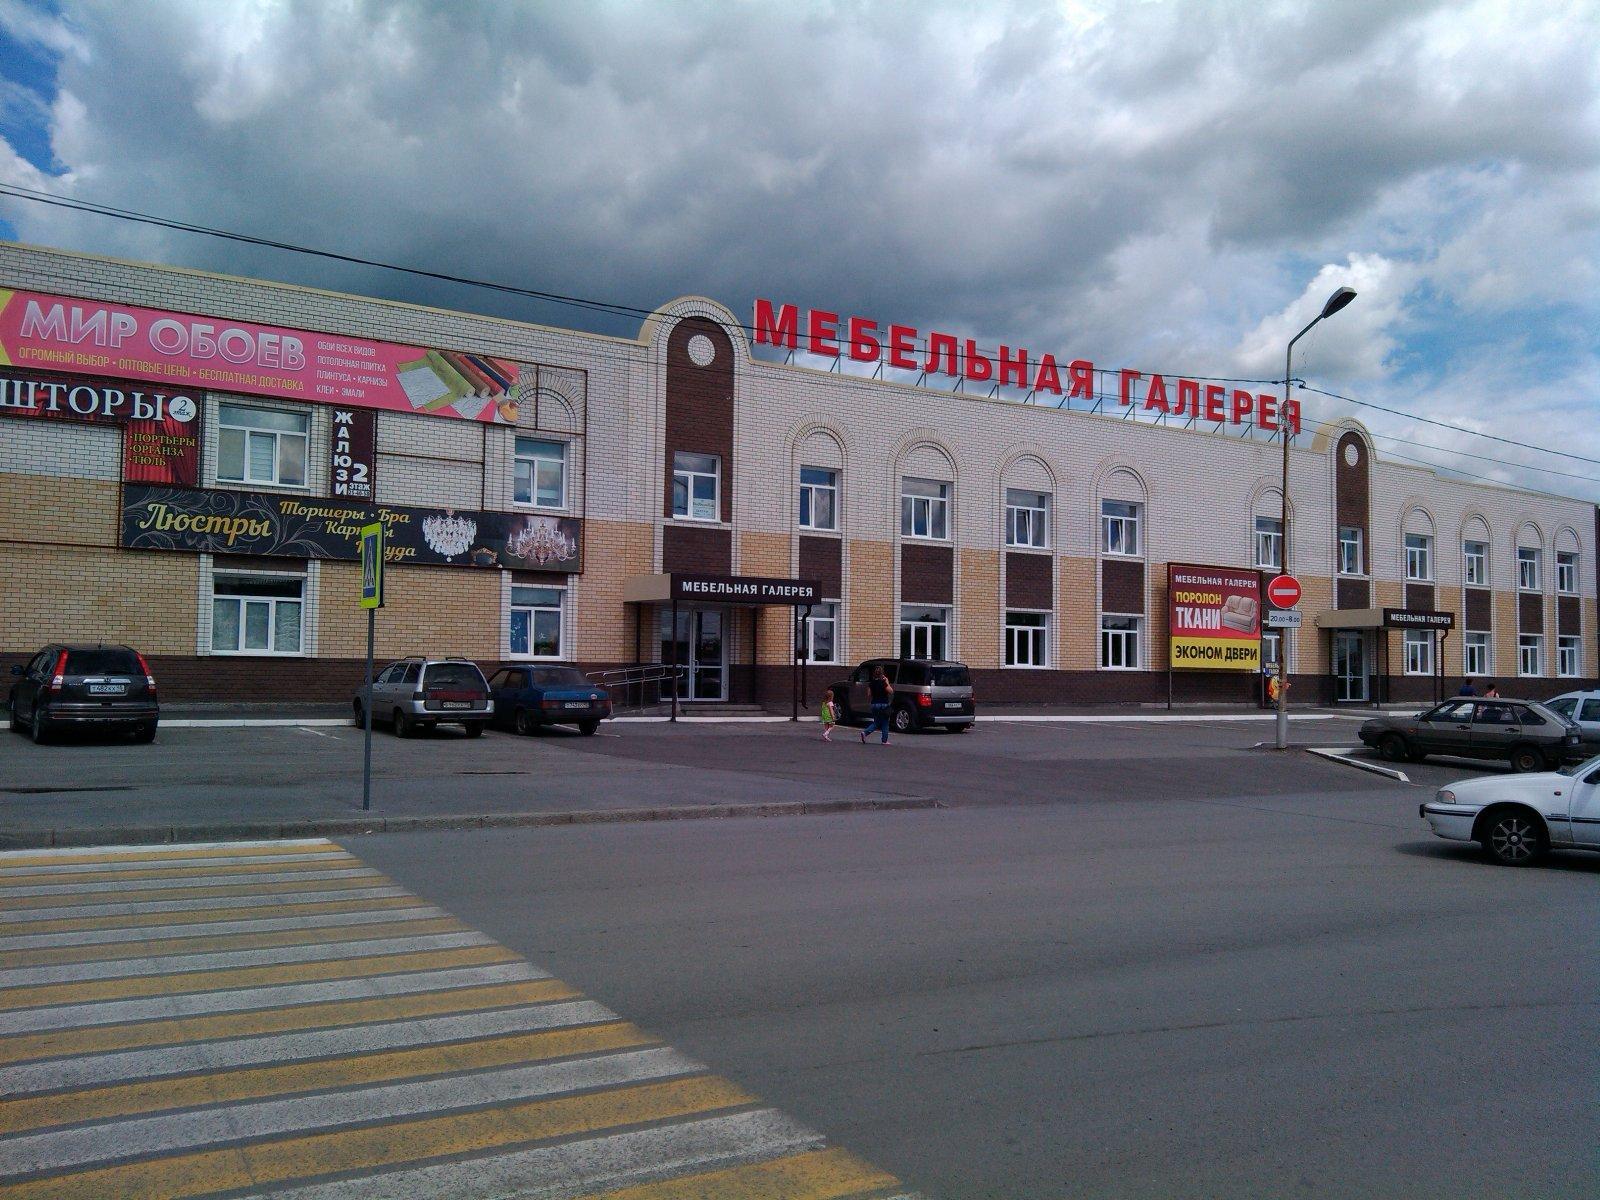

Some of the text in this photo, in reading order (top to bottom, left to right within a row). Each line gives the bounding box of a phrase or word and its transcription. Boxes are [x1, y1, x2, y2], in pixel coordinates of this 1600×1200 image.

[20, 300, 307, 371] МИР ОБОЕВ
[317, 341, 376, 357] ОБОИ ВСЕХ ВИДОВ
[19, 347, 305, 392] ОГРОМНЫЙ ВЫБОР ОПТОВЫЕ ЦЕНЫ БЕСПЛАТНАЯ ДОСТАВКА
[317, 355, 386, 372] ПОТОЛОЧНАЯ ПЛИТКА
[753, 299, 1302, 435] МЕБЕЛЬНАЯ ГАЛЕРЕЯ
[316, 369, 388, 387] ПЛИНТУСА КАРНИЗЫ
[0, 379, 168, 421] ШТОРЫ
[341, 387, 365, 398] ЭМАЛИ
[178, 399, 188, 411] 2
[134, 433, 195, 447] ПОРТЬЕРЫ
[133, 444, 185, 458] ОРГАНЗА
[133, 455, 166, 467] ТЮЛЬ
[352, 463, 368, 482] 2
[349, 482, 371, 491] этаж
[279, 501, 411, 527] Торшеры Бра
[139, 502, 272, 546] Люстры
[682, 581, 813, 597] МЕБЕЛЬНАЯ ГАЛЕРЕЯ
[1175, 574, 1257, 589] МЕБЕЛЬНАЯ ГАЛЕРЕЯ
[1175, 591, 1222, 605] ПОРОЛОН
[1175, 607, 1221, 630] ТКАНИ
[1391, 613, 1451, 624] МЕБЕЛЬНАЯ ГАЛЕРЕЯ
[1175, 645, 1257, 661] ЭКОНОМ ДВЕРИ
